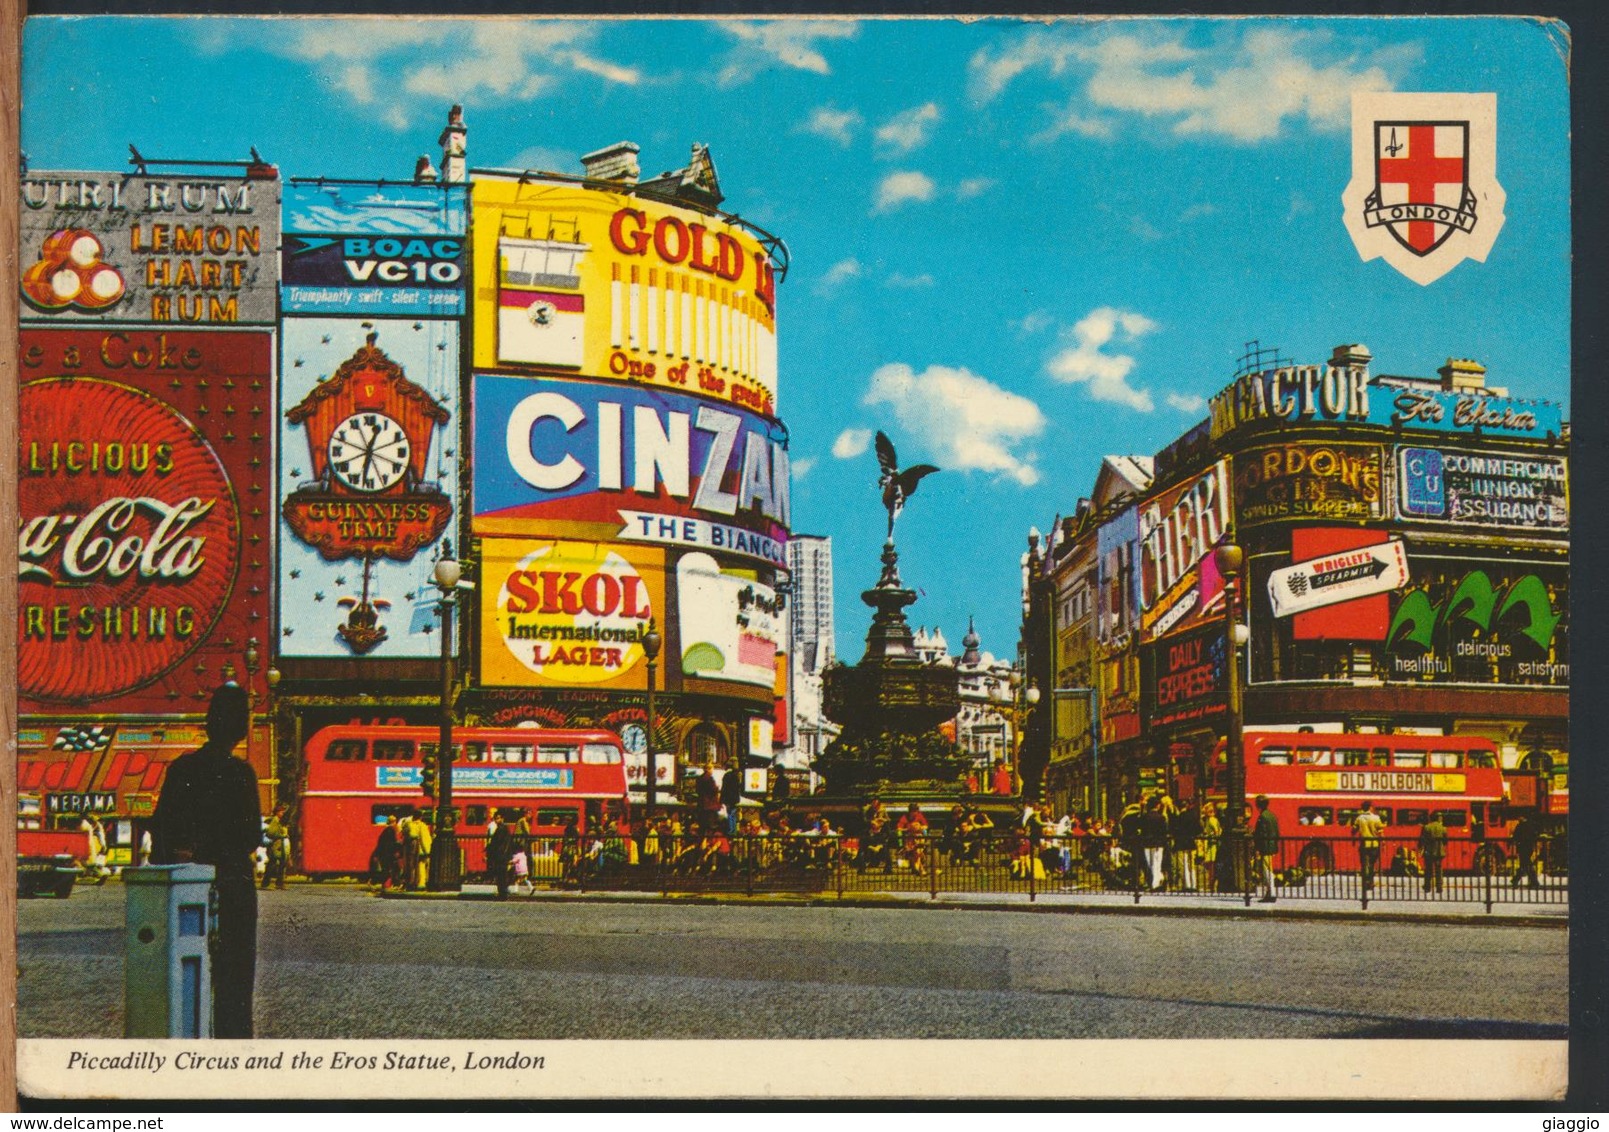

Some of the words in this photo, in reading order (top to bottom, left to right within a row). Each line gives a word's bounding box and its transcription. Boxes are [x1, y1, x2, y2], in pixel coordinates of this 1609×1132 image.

[144, 180, 254, 214] RUM
[1376, 206, 1468, 227] LONDON
[130, 222, 260, 255] LEMON
[343, 238, 463, 259] BOAC
[609, 207, 745, 282] GOLD
[146, 258, 247, 290] HART
[343, 260, 462, 284] VC10
[151, 293, 239, 322] RUM
[290, 287, 352, 305] Triumphantly
[357, 288, 384, 304] swift
[391, 289, 420, 304] silent
[62, 344, 83, 369] a
[100, 331, 203, 370] Coke
[609, 351, 657, 380] One
[667, 362, 690, 386] of
[698, 366, 727, 394] the
[1393, 392, 1445, 423] For
[1453, 396, 1538, 431] Charm
[28, 440, 177, 476] LICIOUS
[1443, 455, 1565, 481] COMMERCIAL
[1477, 478, 1536, 499] UNION
[307, 501, 430, 521] GUINNESS
[18, 496, 216, 580] a-Cola
[338, 521, 400, 541] TIME
[637, 514, 698, 543] THE
[1312, 551, 1373, 574] WRIGLEY'S
[1316, 564, 1376, 586] SPEARMINT
[505, 569, 652, 618] SKOL
[507, 618, 647, 645] International
[532, 646, 623, 668] LAGER
[1169, 638, 1203, 673] DAILY
[1456, 638, 1512, 659] delicious
[1394, 655, 1452, 674] healthful
[1517, 659, 1570, 682] satisfyin
[557, 690, 610, 703] LEADING
[1340, 773, 1367, 791] OLD
[1371, 773, 1434, 792] HOLBORN
